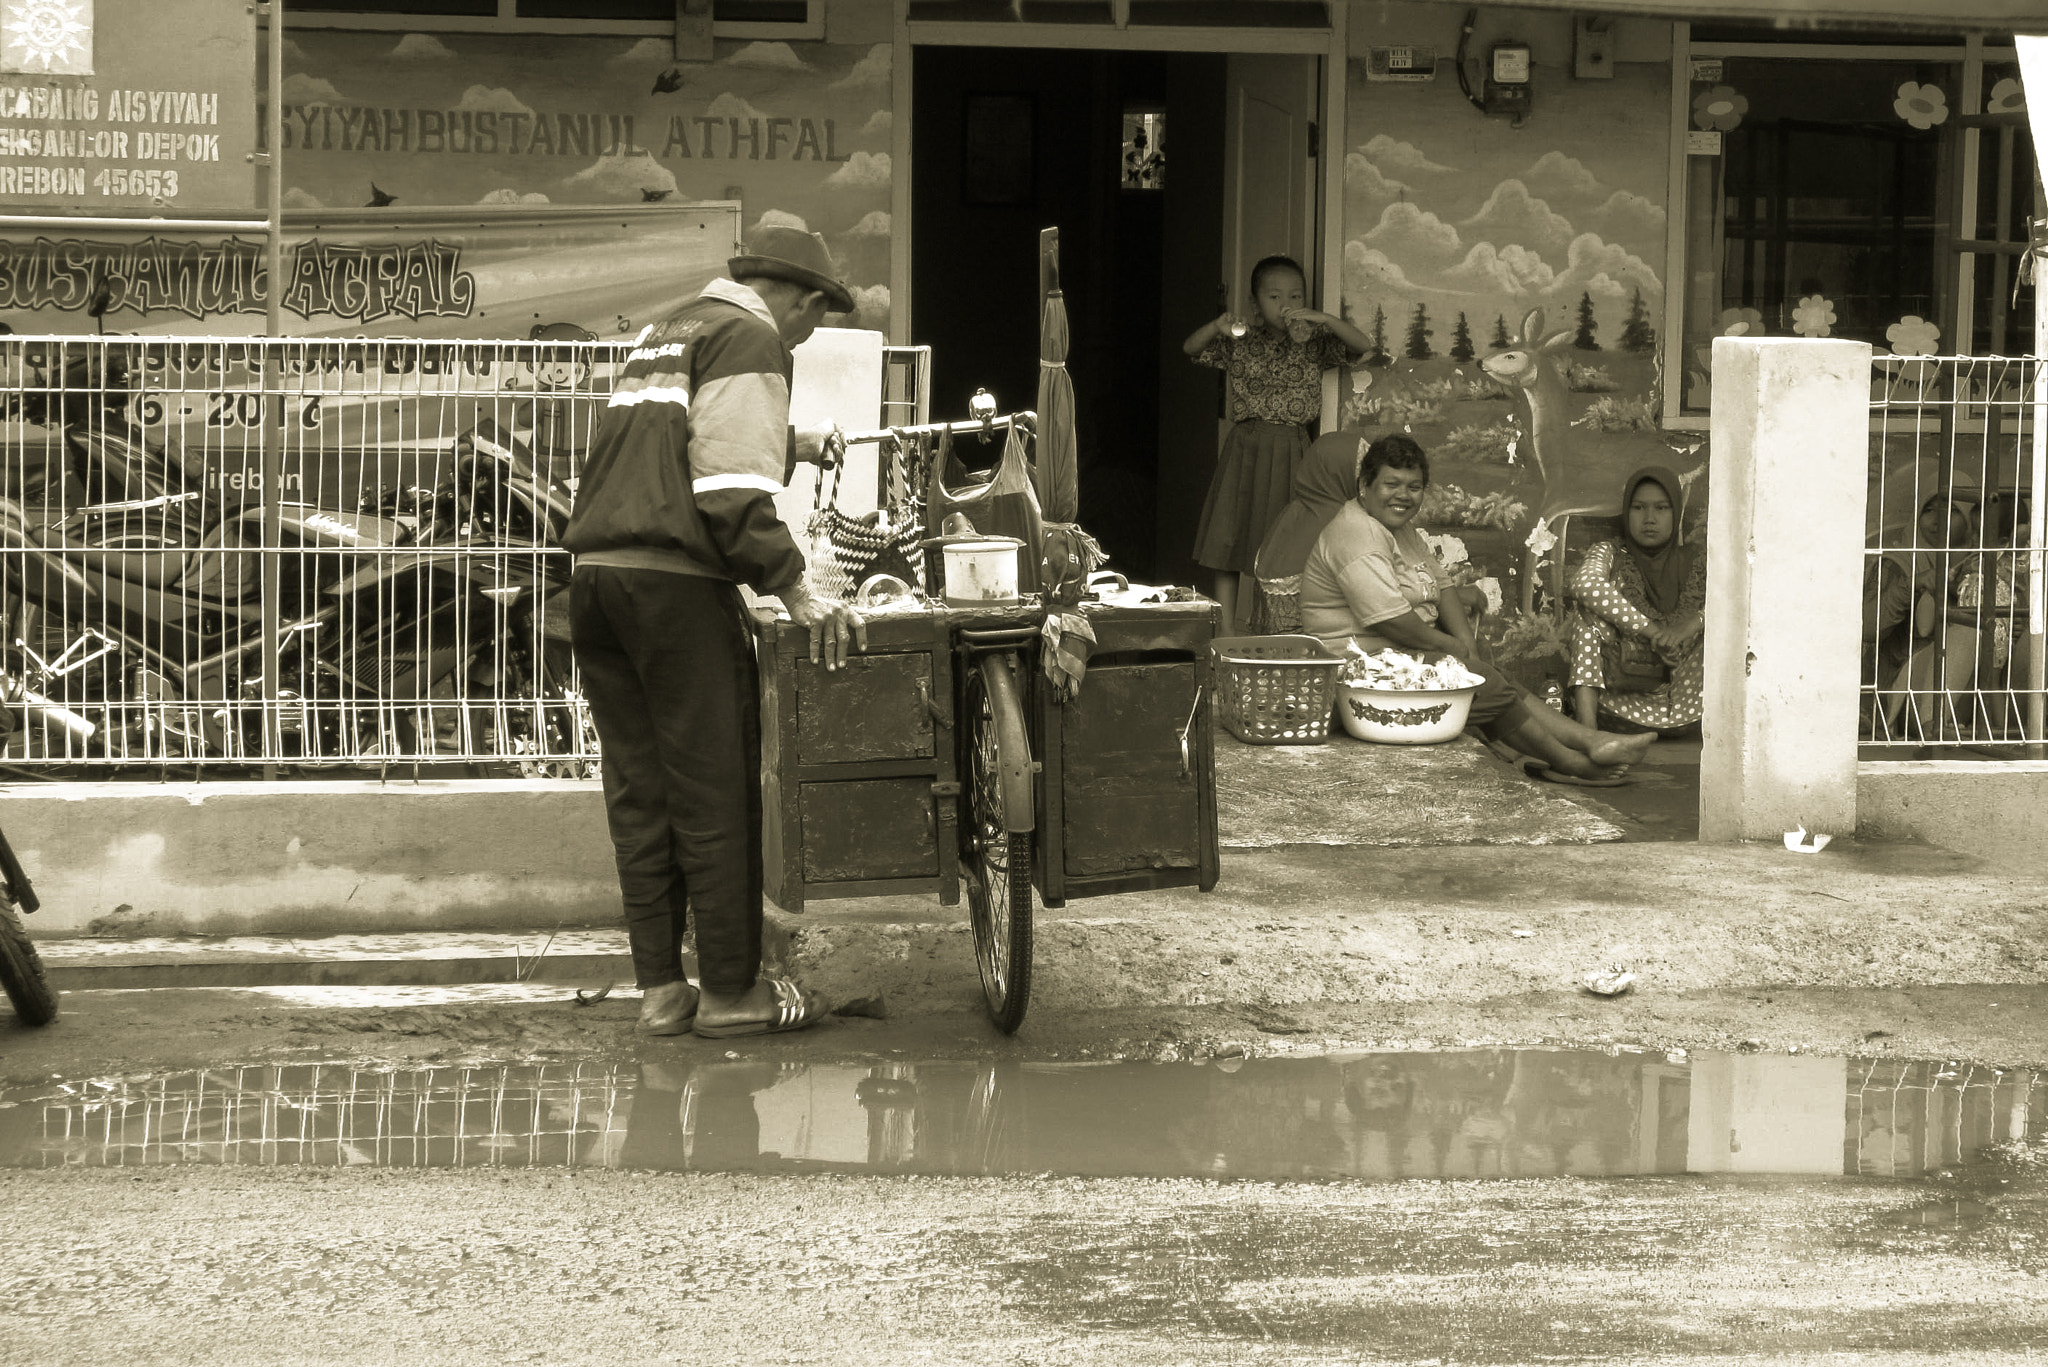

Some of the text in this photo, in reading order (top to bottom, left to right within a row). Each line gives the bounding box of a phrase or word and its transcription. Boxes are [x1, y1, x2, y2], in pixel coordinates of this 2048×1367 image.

[0, 86, 218, 125] CABANG AISYIYAH
[137, 132, 220, 162] DEPOK
[662, 111, 851, 162] ATHFAL
[0, 166, 179, 197] REBON 45653
